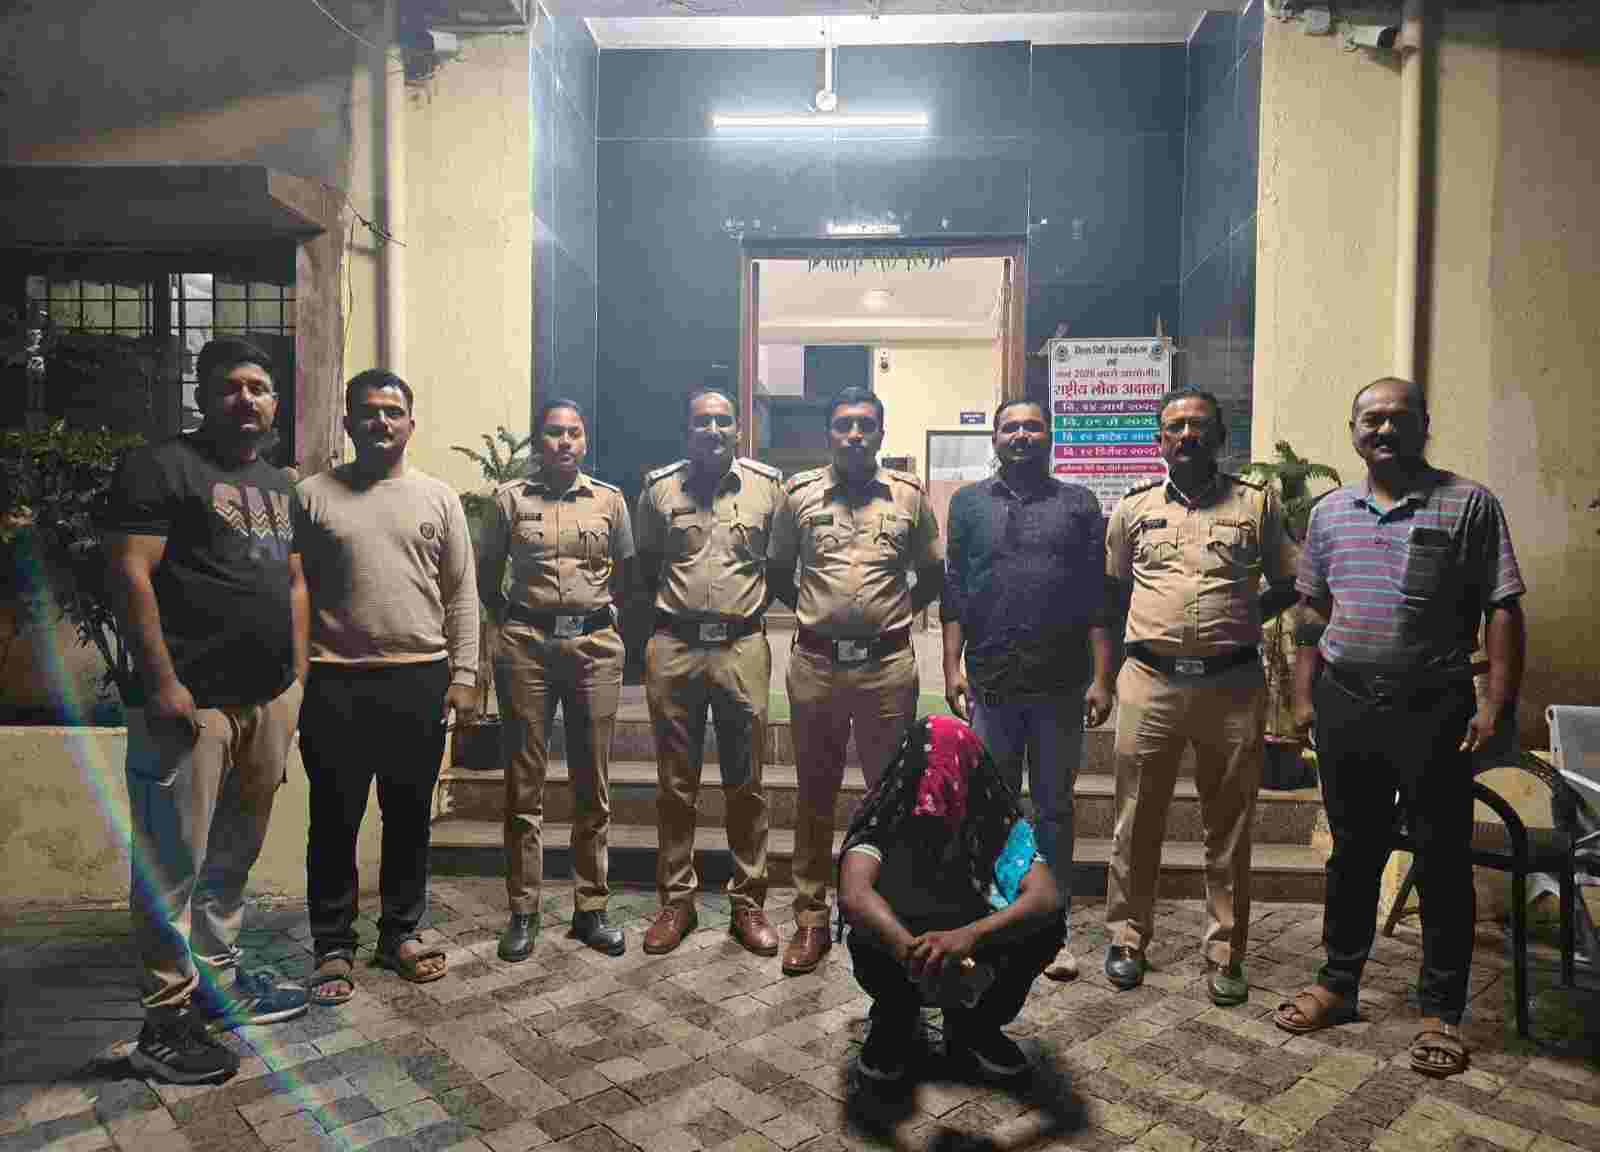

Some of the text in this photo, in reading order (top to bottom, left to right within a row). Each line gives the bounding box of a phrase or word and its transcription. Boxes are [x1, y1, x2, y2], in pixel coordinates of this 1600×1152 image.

[1055, 380, 1165, 399] राष्ट्रीय लोक अदालत
